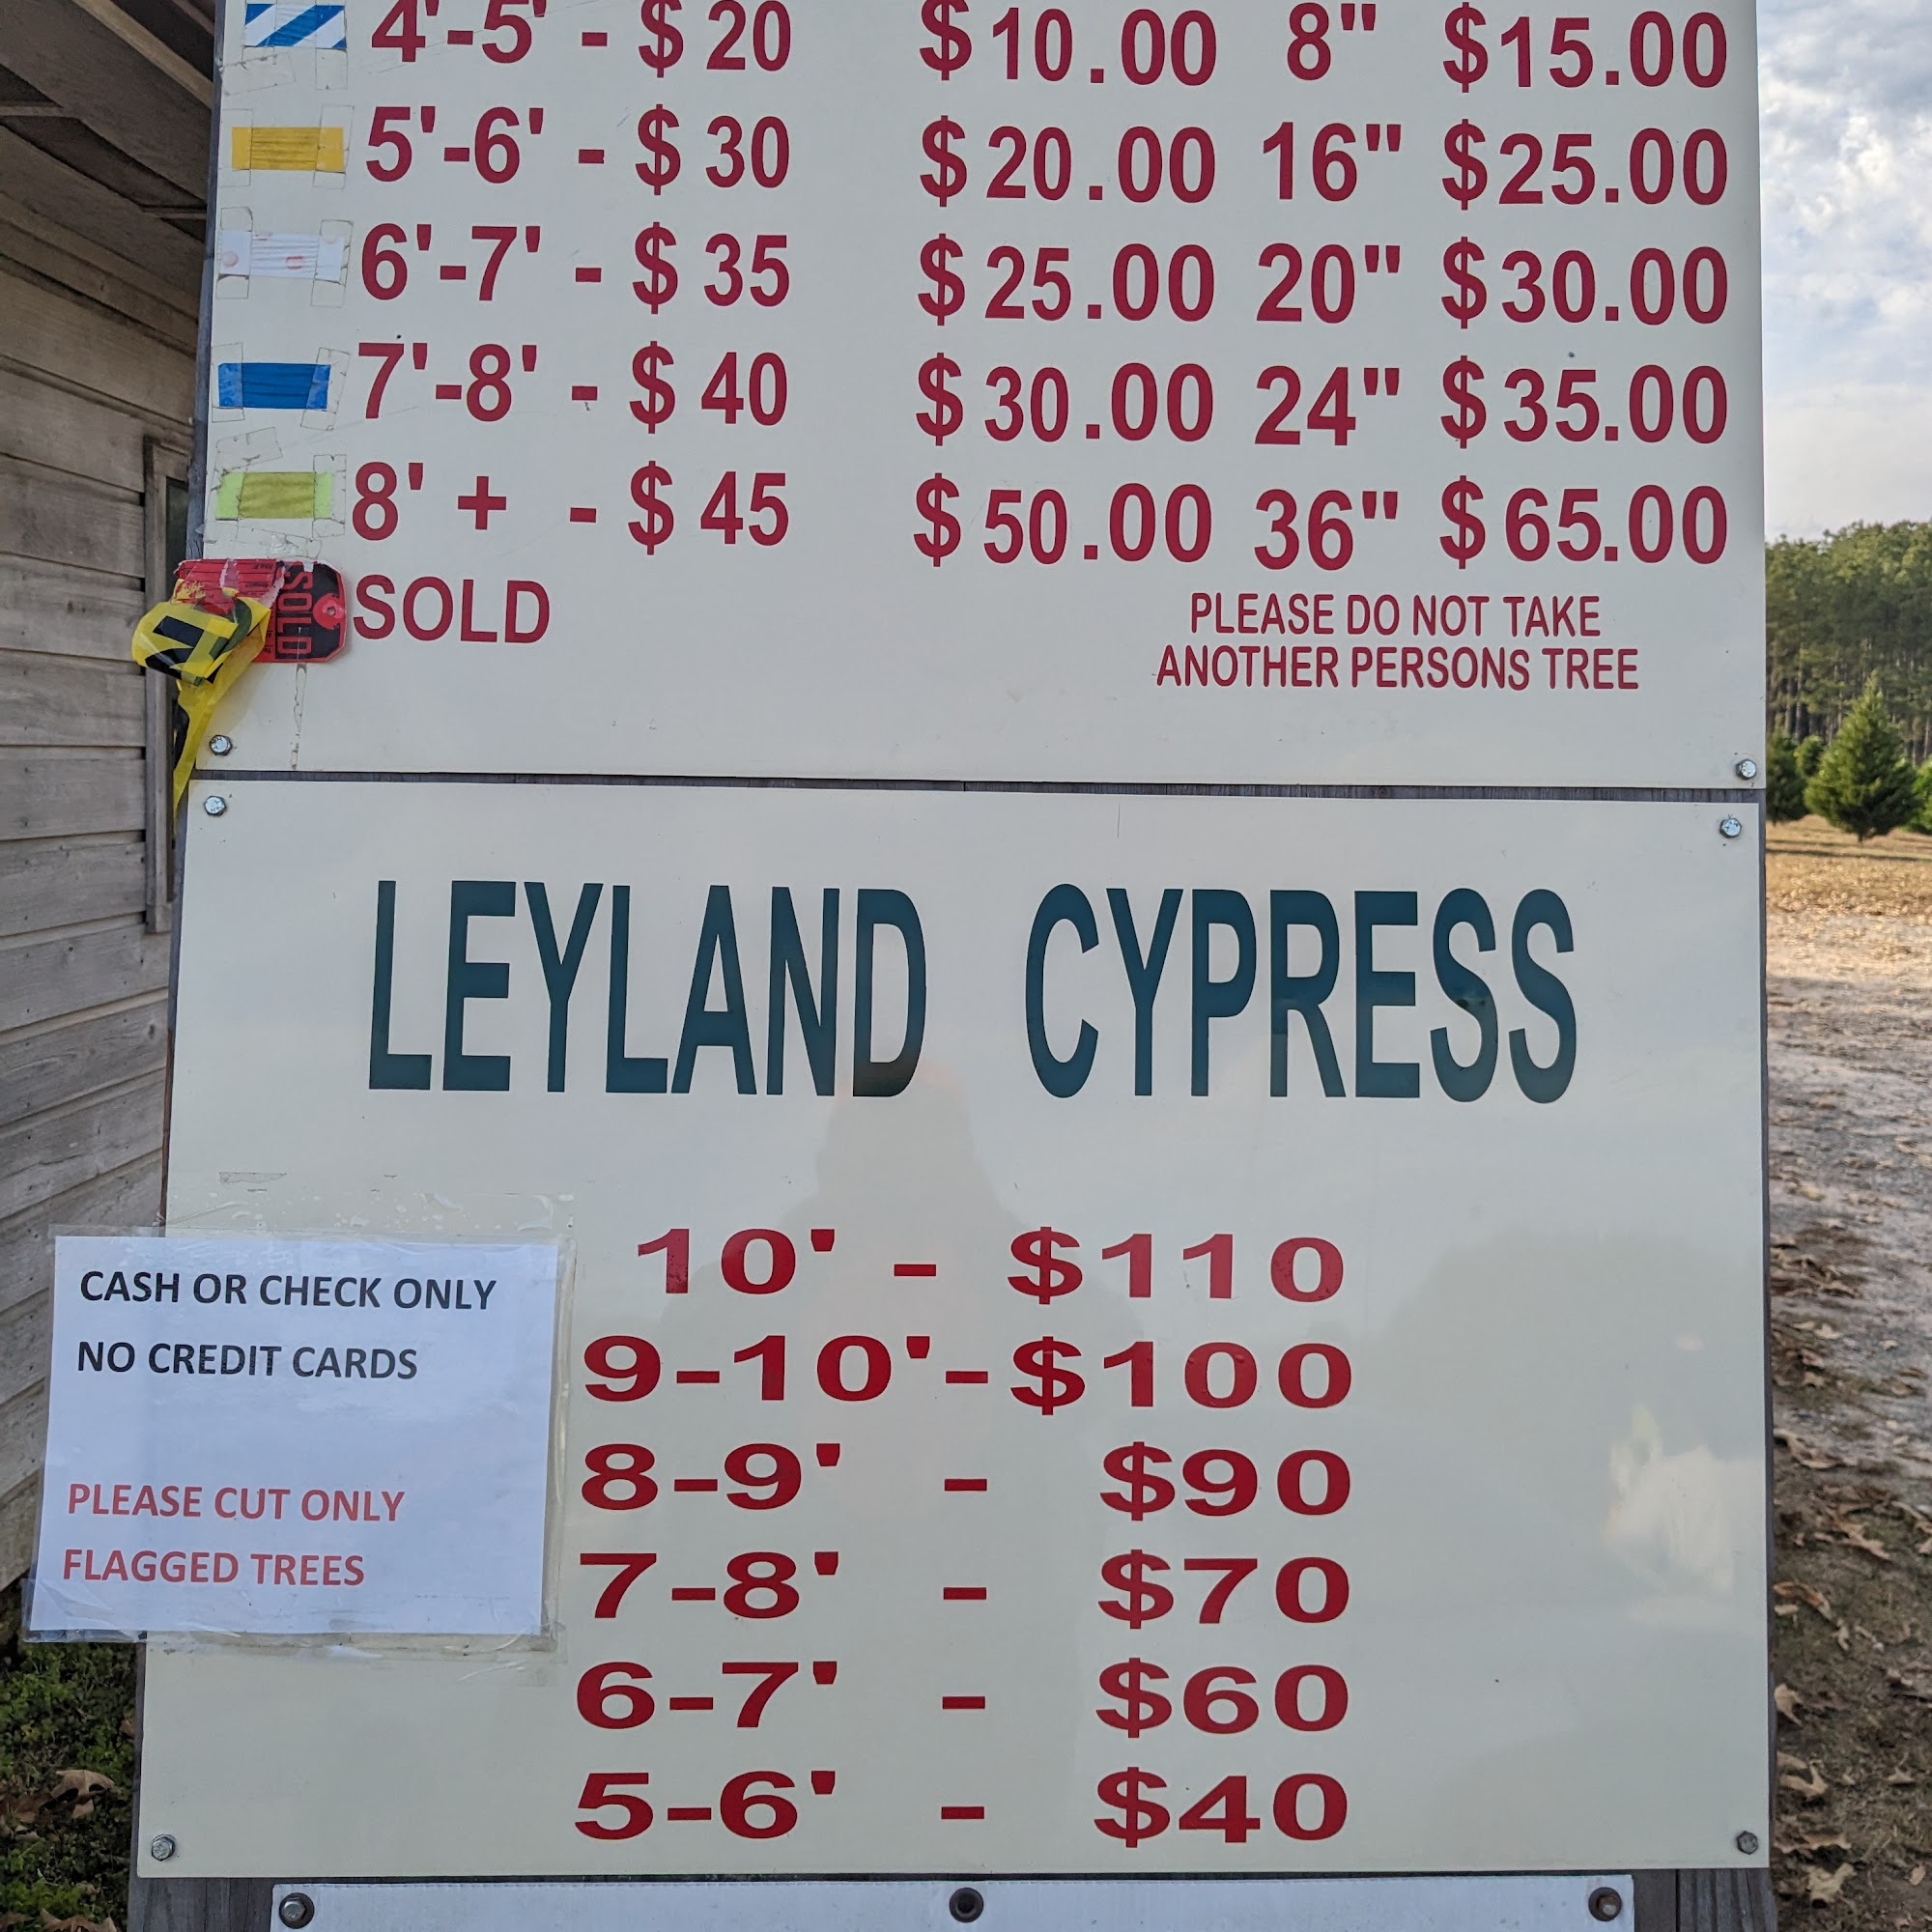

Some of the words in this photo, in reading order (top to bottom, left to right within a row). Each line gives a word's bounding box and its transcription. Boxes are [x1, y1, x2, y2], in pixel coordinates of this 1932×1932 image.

[372, 0, 546, 63] 4'-5'
[1288, 3, 1376, 80] 8"
[367, 106, 543, 183] 5'-6'
[1264, 123, 1401, 201] 16"
[362, 224, 540, 300] 6'-7'
[1257, 243, 1400, 323] 20"
[359, 343, 536, 421] 7'-8'
[1256, 366, 1399, 445] 24"
[1255, 490, 1397, 570] 36"
[354, 575, 549, 642] SOLD
[1192, 593, 1333, 634] PLEASE
[1348, 595, 1399, 635] DO
[1413, 596, 1489, 636] NOT
[1504, 596, 1600, 636] TAKE
[1157, 645, 1338, 687] ANOTHER
[1352, 647, 1529, 690] PERSONS
[1543, 648, 1637, 689] TREE
[369, 881, 926, 1097] LEYLAND
[1026, 884, 1577, 1103] CYPRESS
[81, 1271, 179, 1302] CASH
[193, 1274, 246, 1304] OR
[260, 1275, 382, 1307] CHECK
[394, 1279, 497, 1309] ONLY
[639, 1229, 835, 1294] 10'
[1009, 1227, 1343, 1304] $110
[78, 1342, 135, 1372] NO
[149, 1344, 281, 1376] CREDIT
[293, 1347, 416, 1379] CARDS
[70, 1484, 201, 1517] PLEASE
[215, 1488, 290, 1519] CUT
[302, 1490, 403, 1520] ONLY
[582, 1443, 840, 1510] 8-9'
[1100, 1442, 1350, 1520] $90
[65, 1549, 238, 1582] FLAGGED
[251, 1554, 363, 1585] TREES
[581, 1552, 838, 1618] 7-8'
[1099, 1549, 1349, 1629] $70
[578, 1662, 837, 1729] 6-7'
[1097, 1658, 1348, 1738] $60
[576, 1771, 835, 1839] 5-6'
[1094, 1767, 1347, 1847] $40
